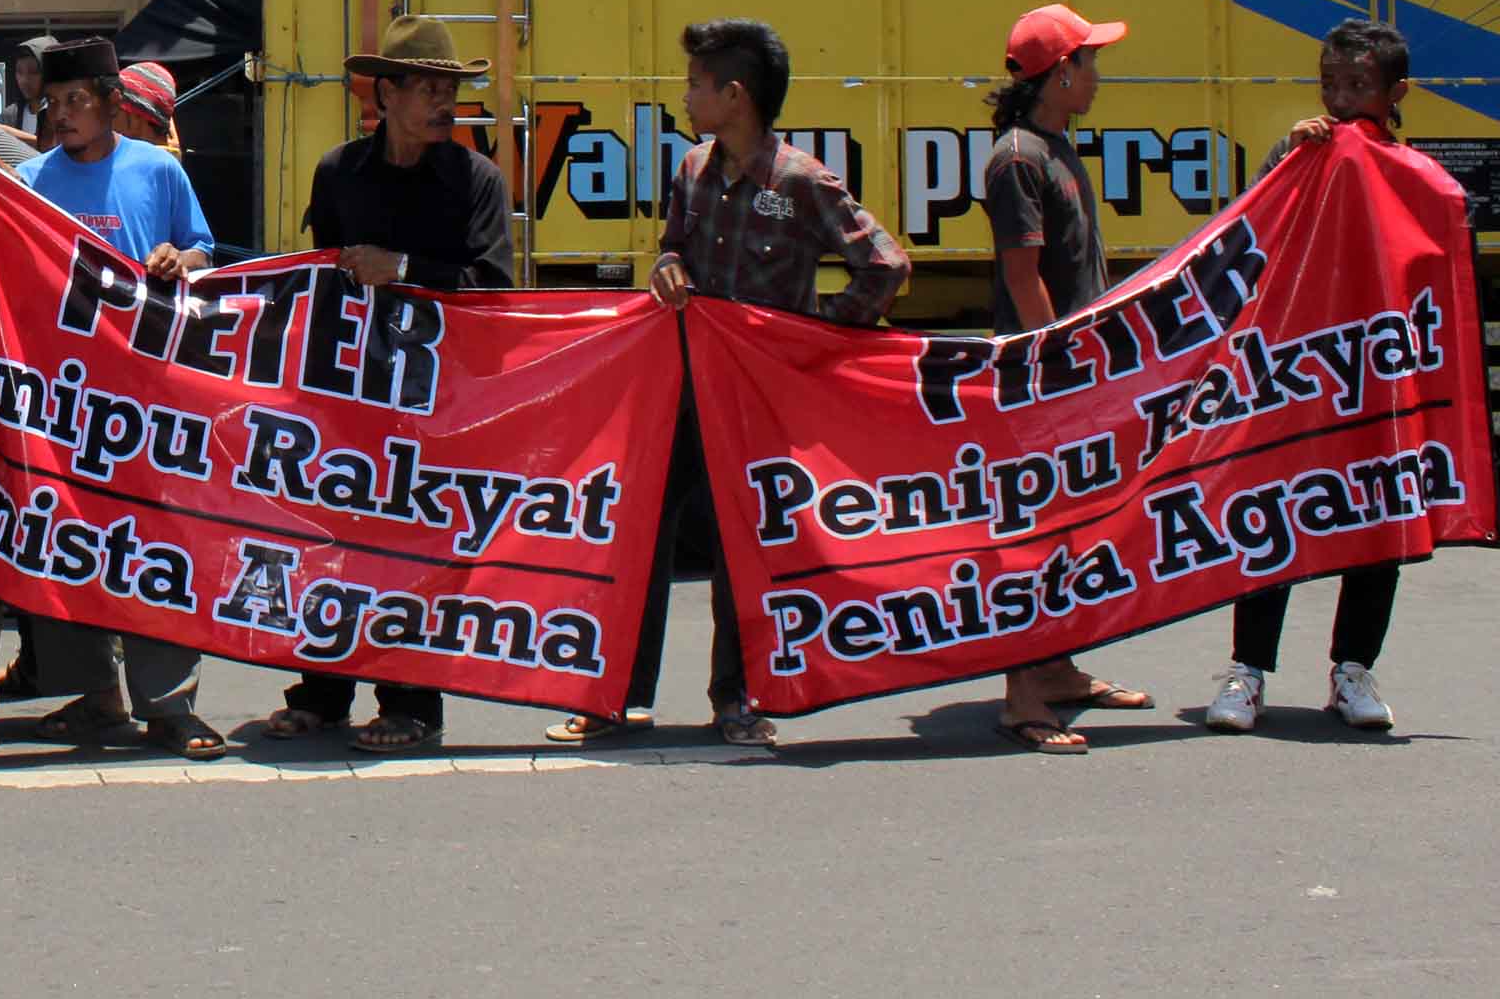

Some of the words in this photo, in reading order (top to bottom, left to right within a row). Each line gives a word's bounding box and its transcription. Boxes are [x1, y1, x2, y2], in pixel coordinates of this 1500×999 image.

[57, 234, 446, 416] PIETER
[747, 432, 1120, 546] Penipu
[1135, 287, 1442, 470] Rakyat
[914, 215, 1268, 424] PIETER
[231, 405, 621, 556] Rakyat
[762, 539, 1137, 676] Penista
[1145, 441, 1465, 577] Agama
[213, 538, 604, 677] Agama
